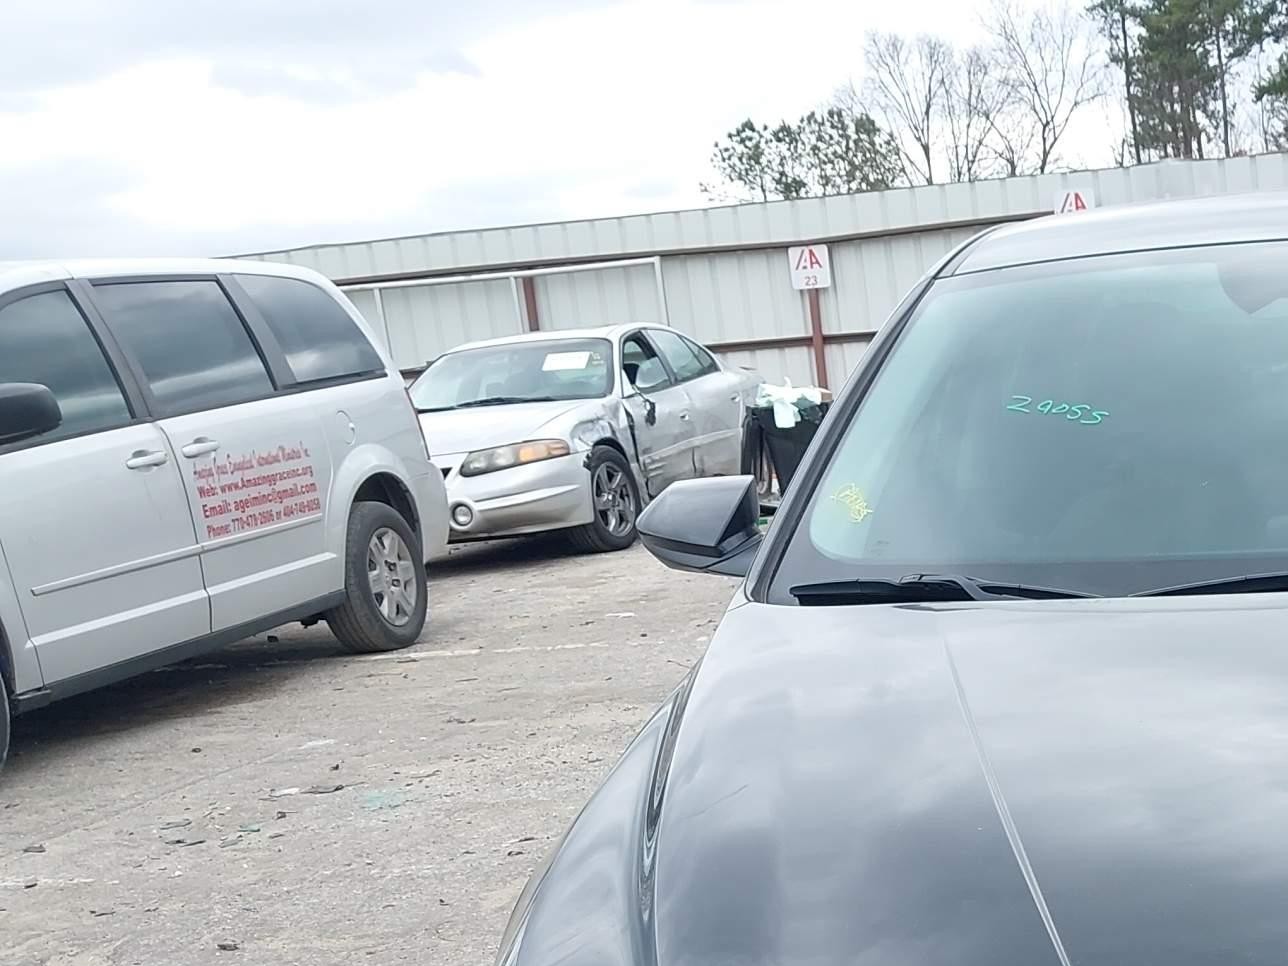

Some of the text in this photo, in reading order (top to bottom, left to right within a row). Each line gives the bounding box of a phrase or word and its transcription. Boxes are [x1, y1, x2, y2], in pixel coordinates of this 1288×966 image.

[804, 275, 818, 286] 23
[197, 484, 219, 499] Web:
[202, 499, 232, 518] Email:
[206, 523, 232, 539] Phone:
